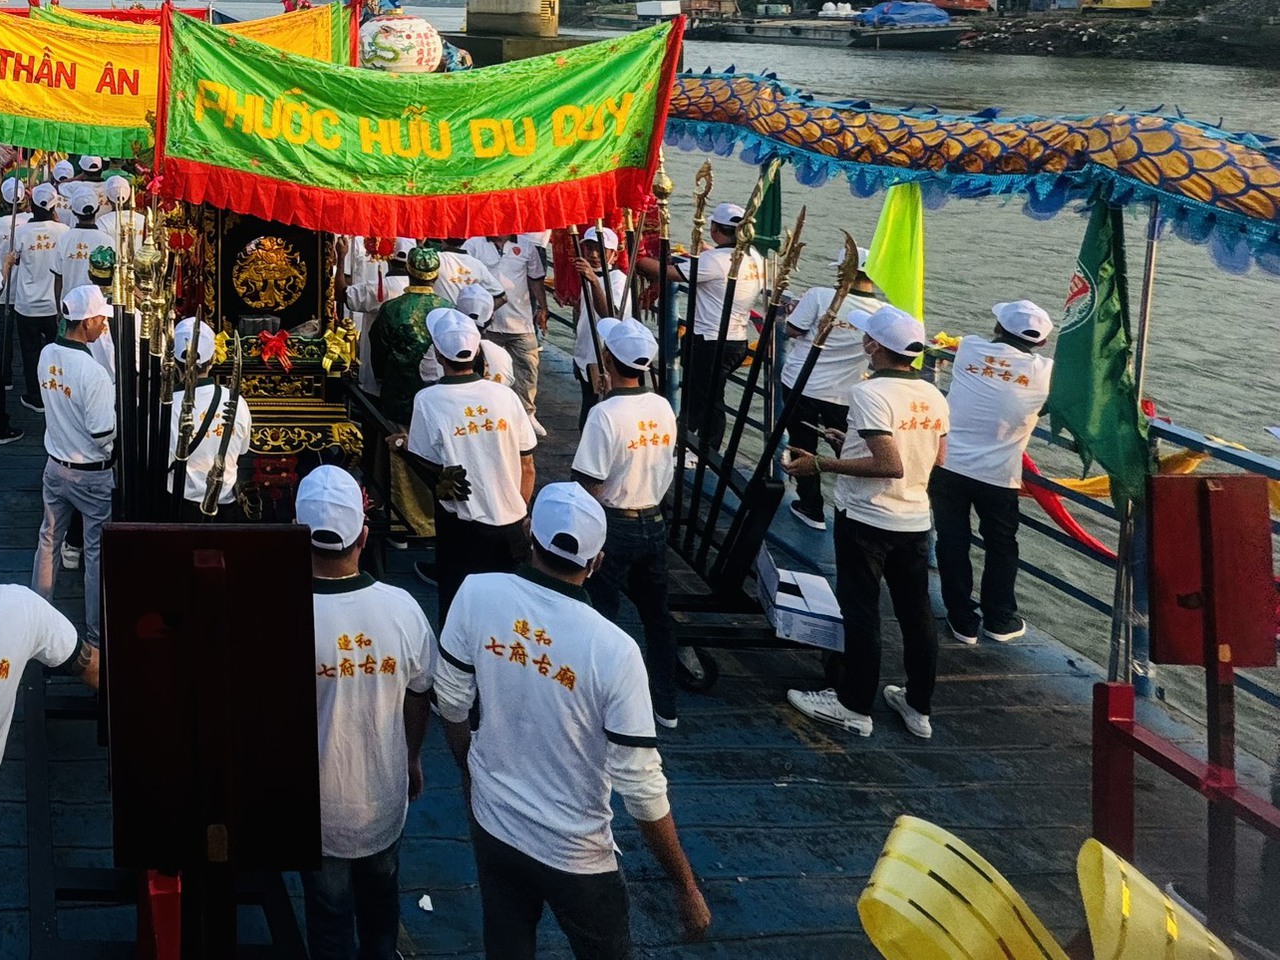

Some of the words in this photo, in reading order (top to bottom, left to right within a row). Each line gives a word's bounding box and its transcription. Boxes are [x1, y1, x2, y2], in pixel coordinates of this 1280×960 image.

[95, 61, 140, 96] ÂN
[194, 78, 343, 150] PHƯỚC
[358, 105, 452, 160] HỮU
[470, 116, 537, 159] DU
[551, 92, 635, 147] DUY
